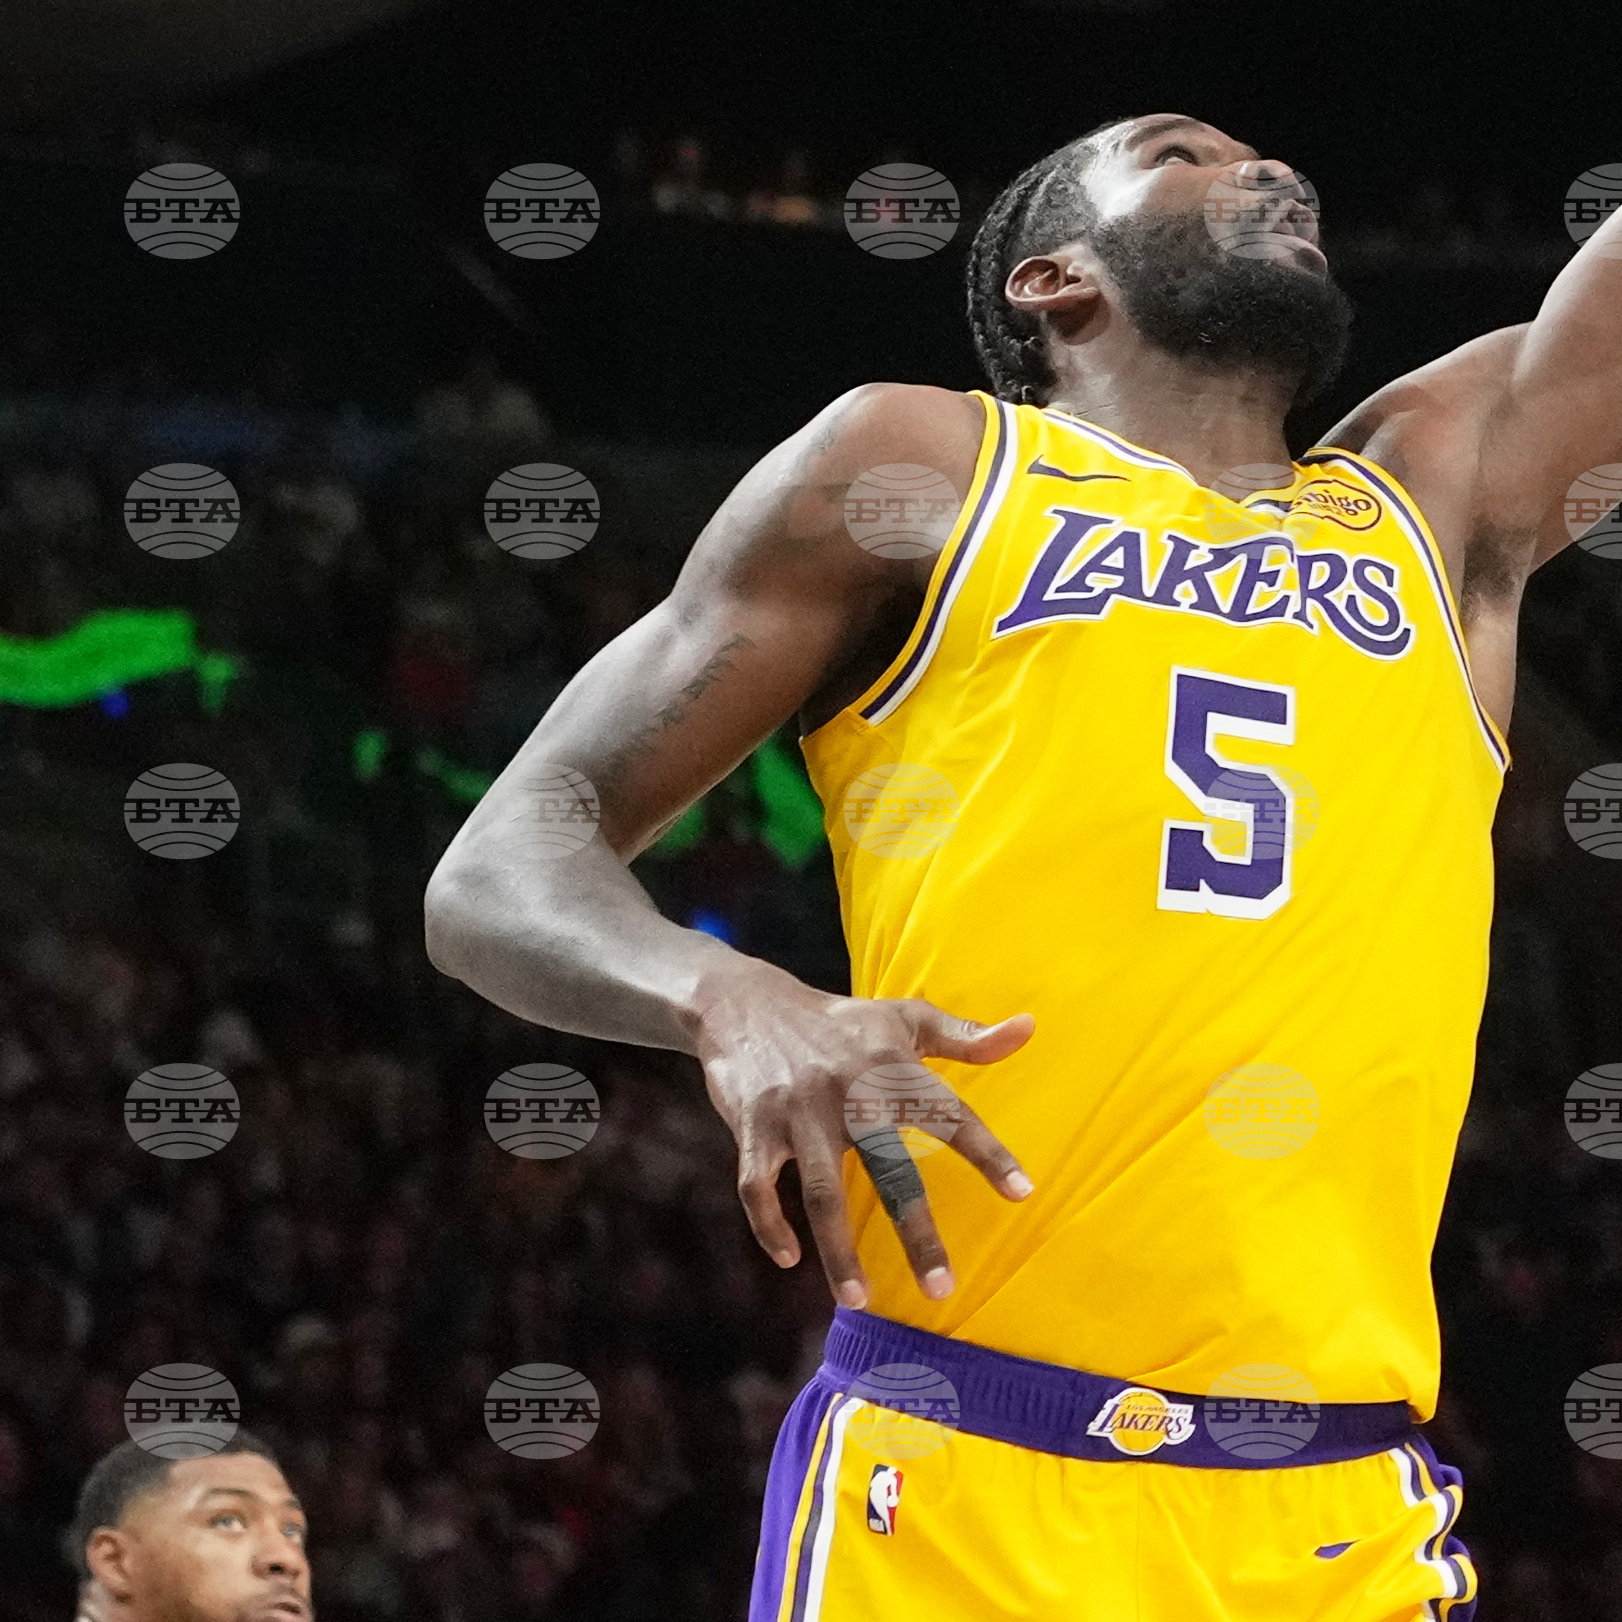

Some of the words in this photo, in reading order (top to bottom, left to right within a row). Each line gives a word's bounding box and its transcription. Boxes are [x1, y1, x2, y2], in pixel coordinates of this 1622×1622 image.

[992, 508, 1416, 660] LAKERS
[1157, 666, 1296, 920] 5
[1091, 1403, 1192, 1440] LAKERS
